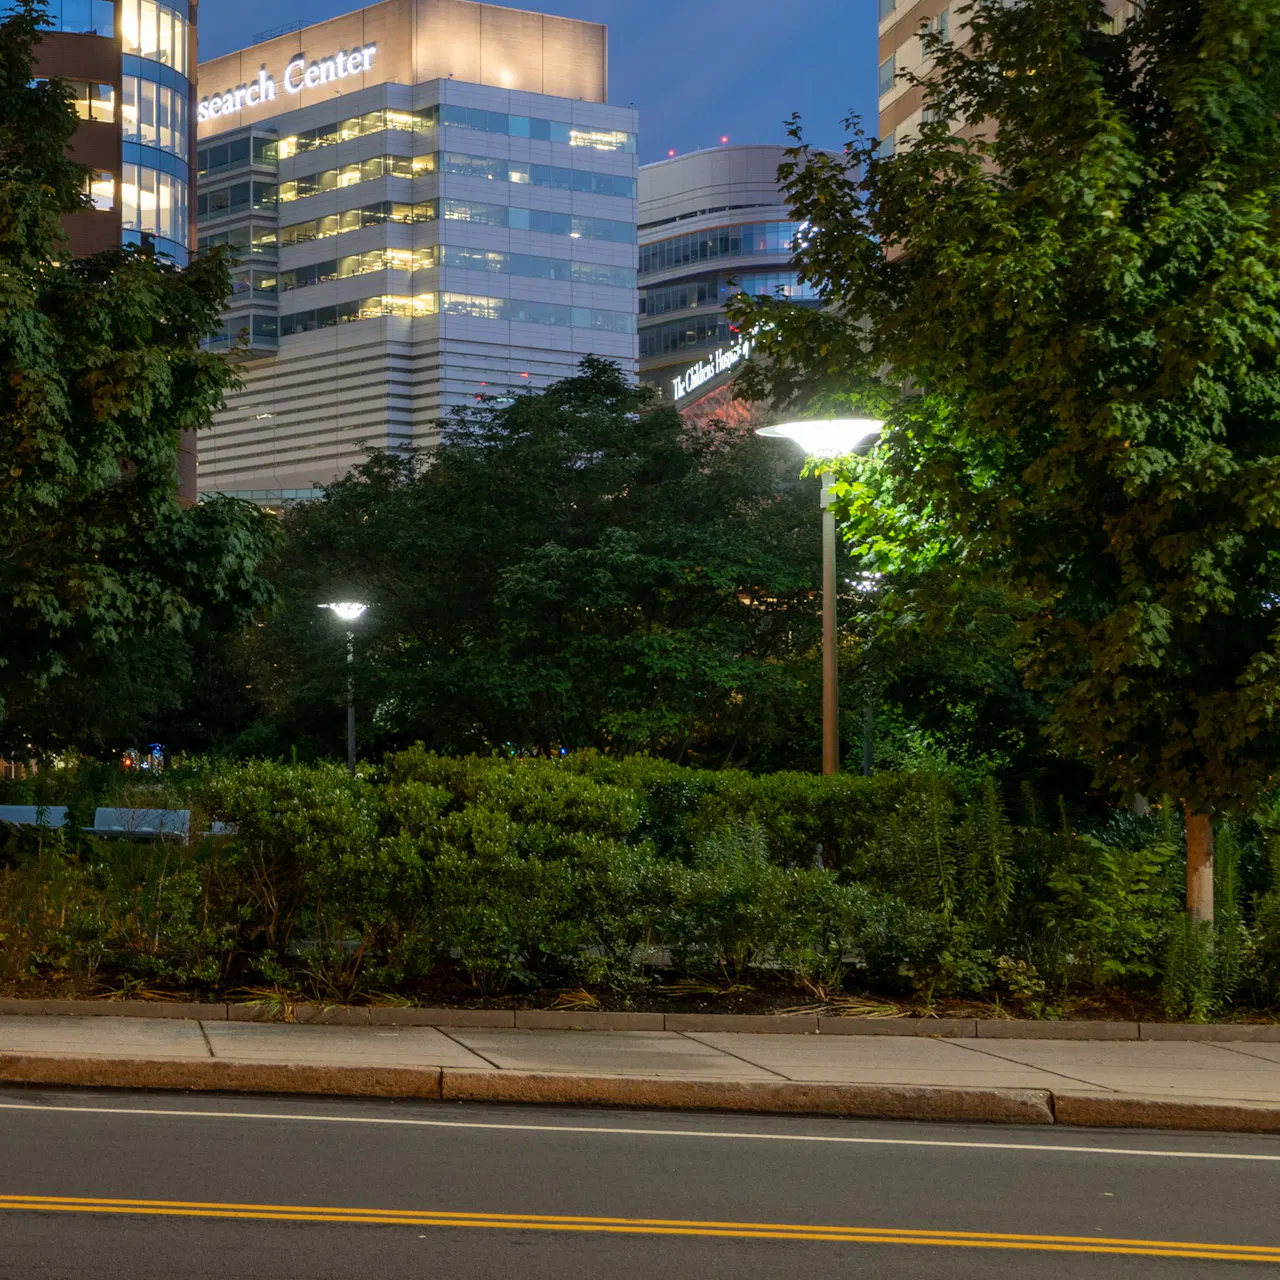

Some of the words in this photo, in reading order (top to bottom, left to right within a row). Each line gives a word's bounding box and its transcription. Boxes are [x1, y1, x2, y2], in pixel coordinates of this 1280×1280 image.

[197, 69, 276, 122] search
[284, 46, 377, 94] Center
[672, 375, 686, 400] The
[685, 354, 715, 392] Children's
